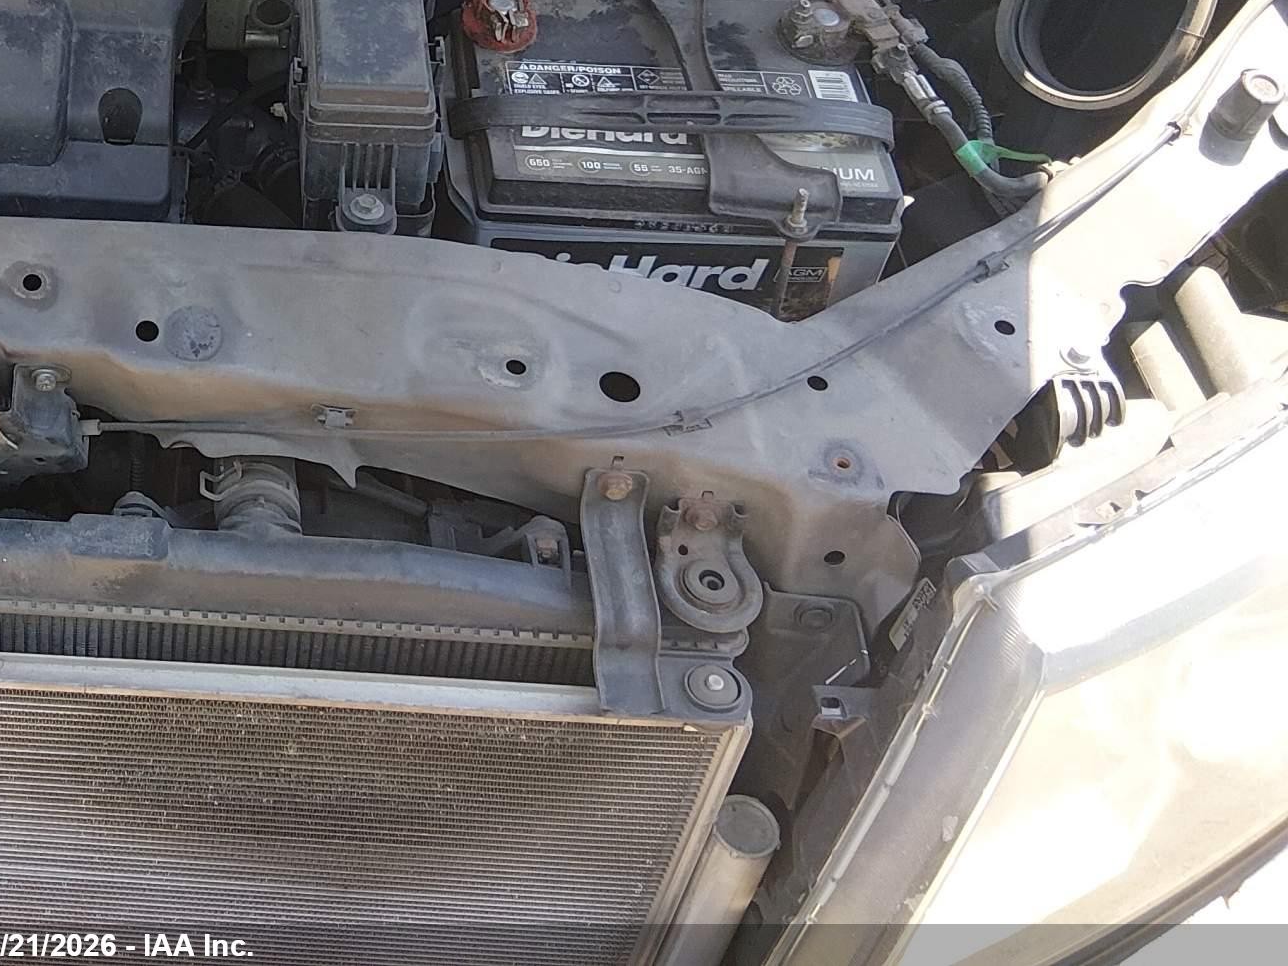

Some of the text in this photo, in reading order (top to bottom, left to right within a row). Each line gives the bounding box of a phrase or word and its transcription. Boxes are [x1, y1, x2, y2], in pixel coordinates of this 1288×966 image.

[528, 64, 621, 74] DANGER/POISON
[581, 161, 601, 169] 100
[633, 164, 649, 172] 55
